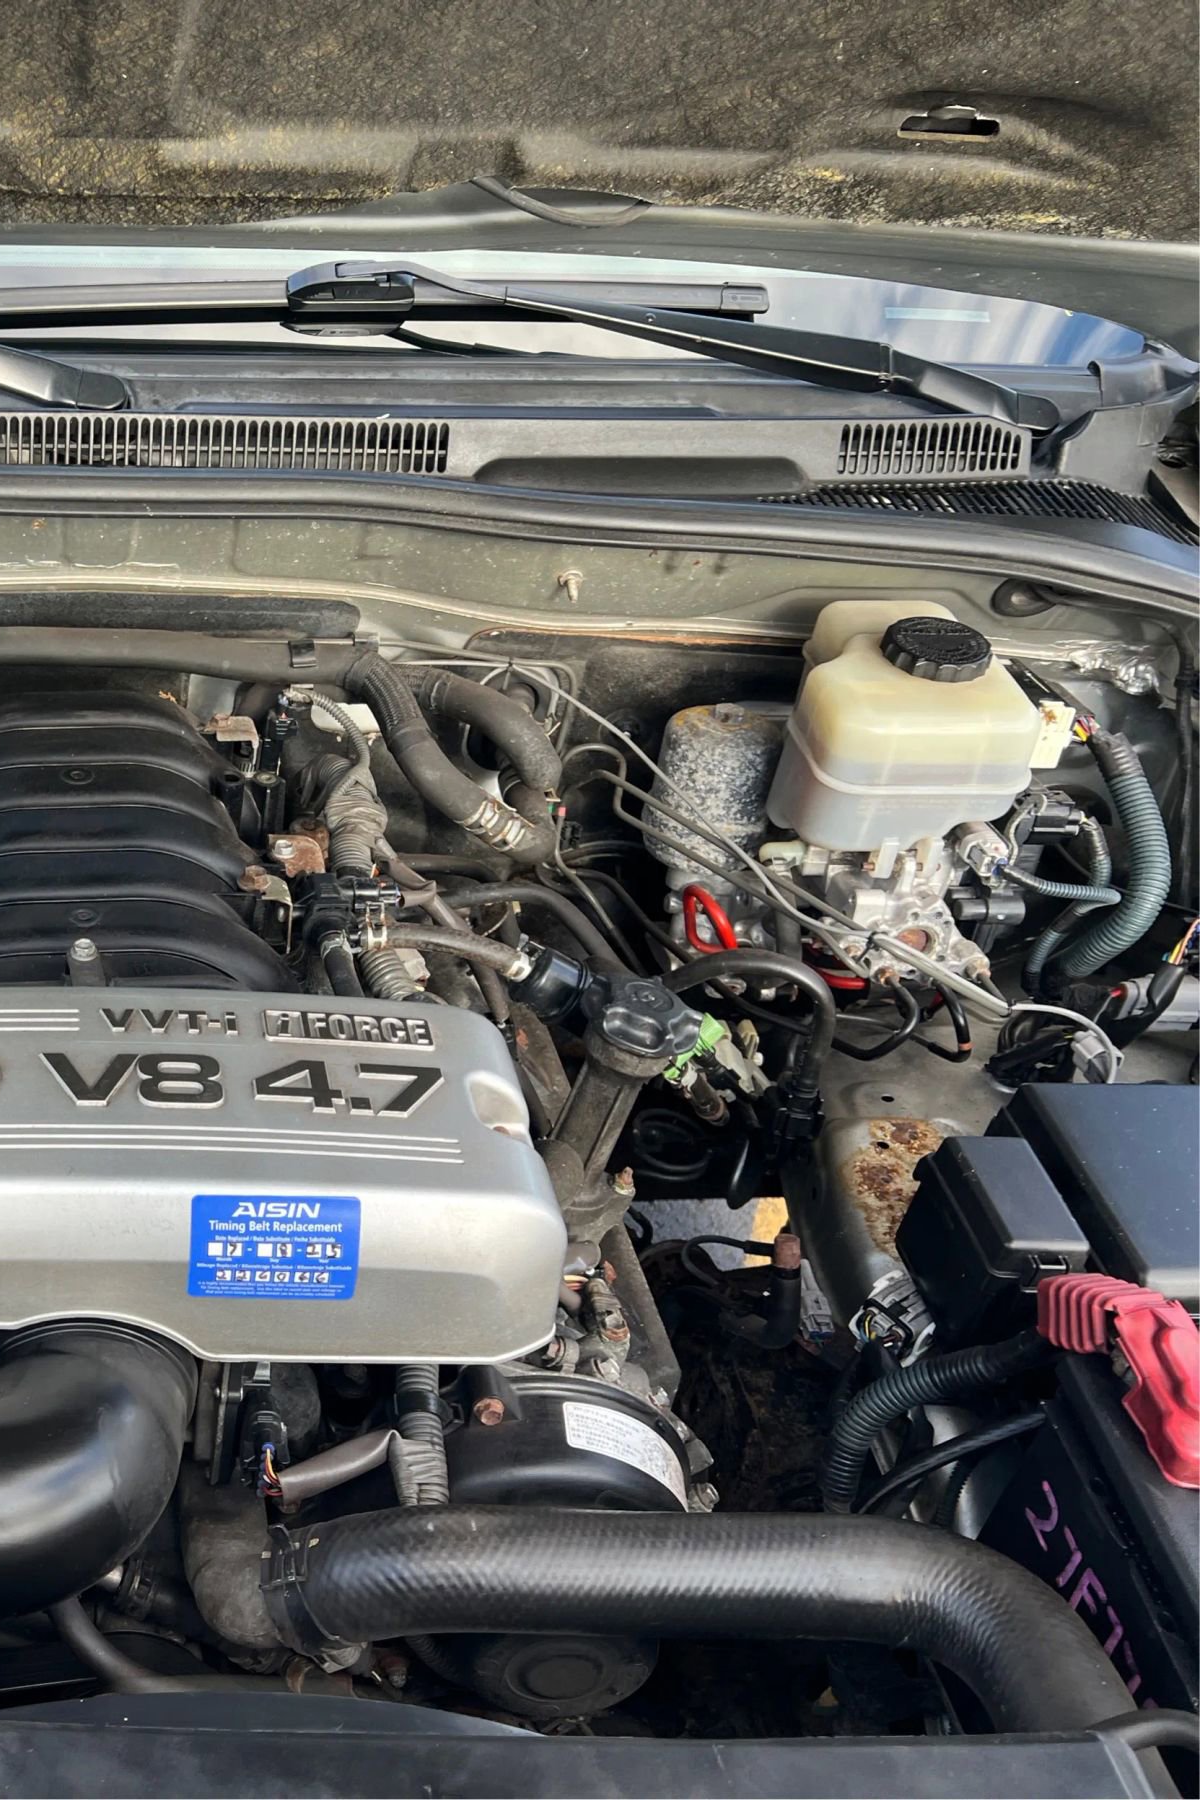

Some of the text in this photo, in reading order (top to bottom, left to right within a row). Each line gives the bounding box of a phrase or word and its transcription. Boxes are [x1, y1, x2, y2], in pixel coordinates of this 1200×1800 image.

[99, 1007, 238, 1036] VVT-i
[39, 1052, 445, 1119] V8 4.7
[231, 1202, 321, 1219] AISIN
[208, 1220, 343, 1235] Timing Belt Replacement
